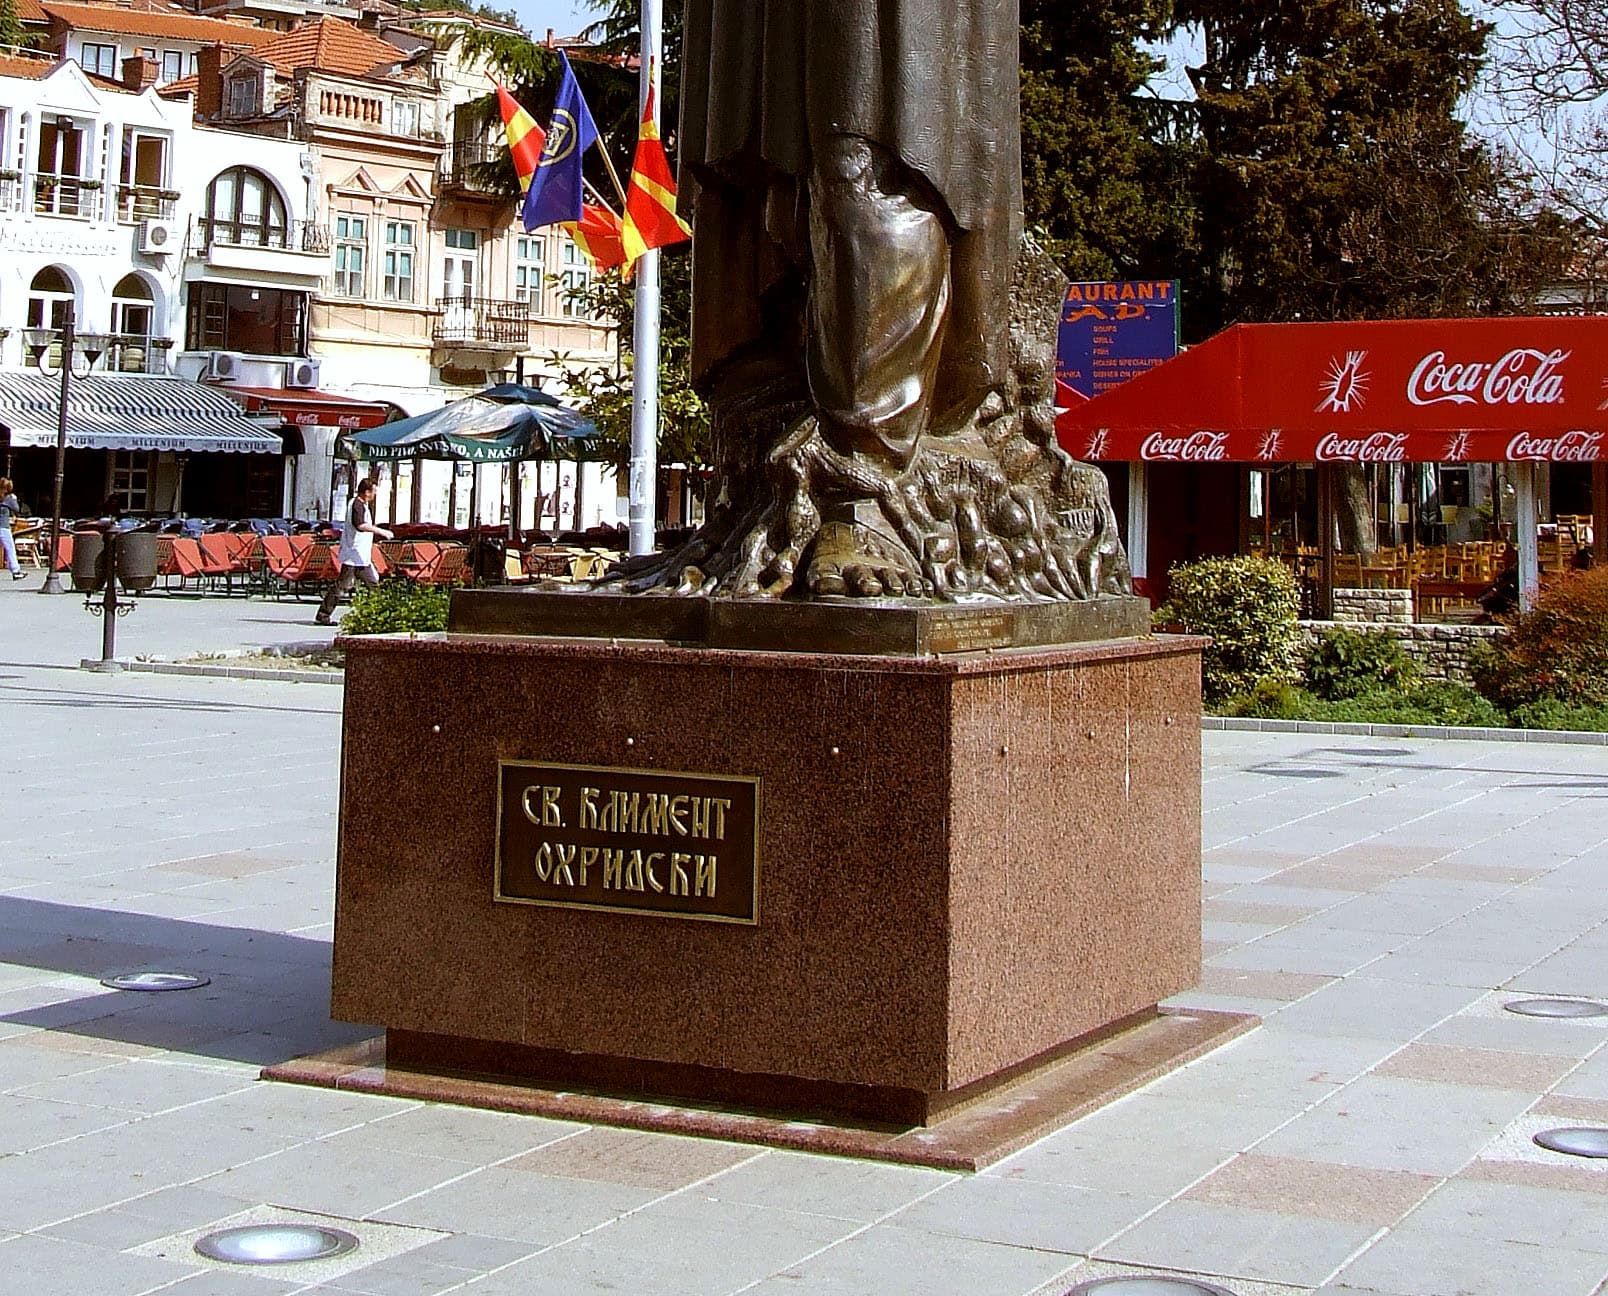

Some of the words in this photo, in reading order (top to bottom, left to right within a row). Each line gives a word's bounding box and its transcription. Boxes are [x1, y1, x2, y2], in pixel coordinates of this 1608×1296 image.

[1067, 282, 1171, 301] AURANT
[1406, 348, 1573, 405] Coca-Cola
[38, 435, 95, 446] MILNIUM
[131, 438, 187, 448] MILLENIUM
[216, 441, 268, 450] MILLENIUM
[474, 447, 483, 458] A
[1140, 431, 1230, 460] Coca-Cola
[1315, 432, 1410, 461] Coca-Cola
[1506, 431, 1605, 461] Coca-Cola
[521, 785, 567, 828] СВ.
[579, 787, 731, 840] КЛИМЕНТ
[535, 842, 717, 898] ОХРИДСКИ
